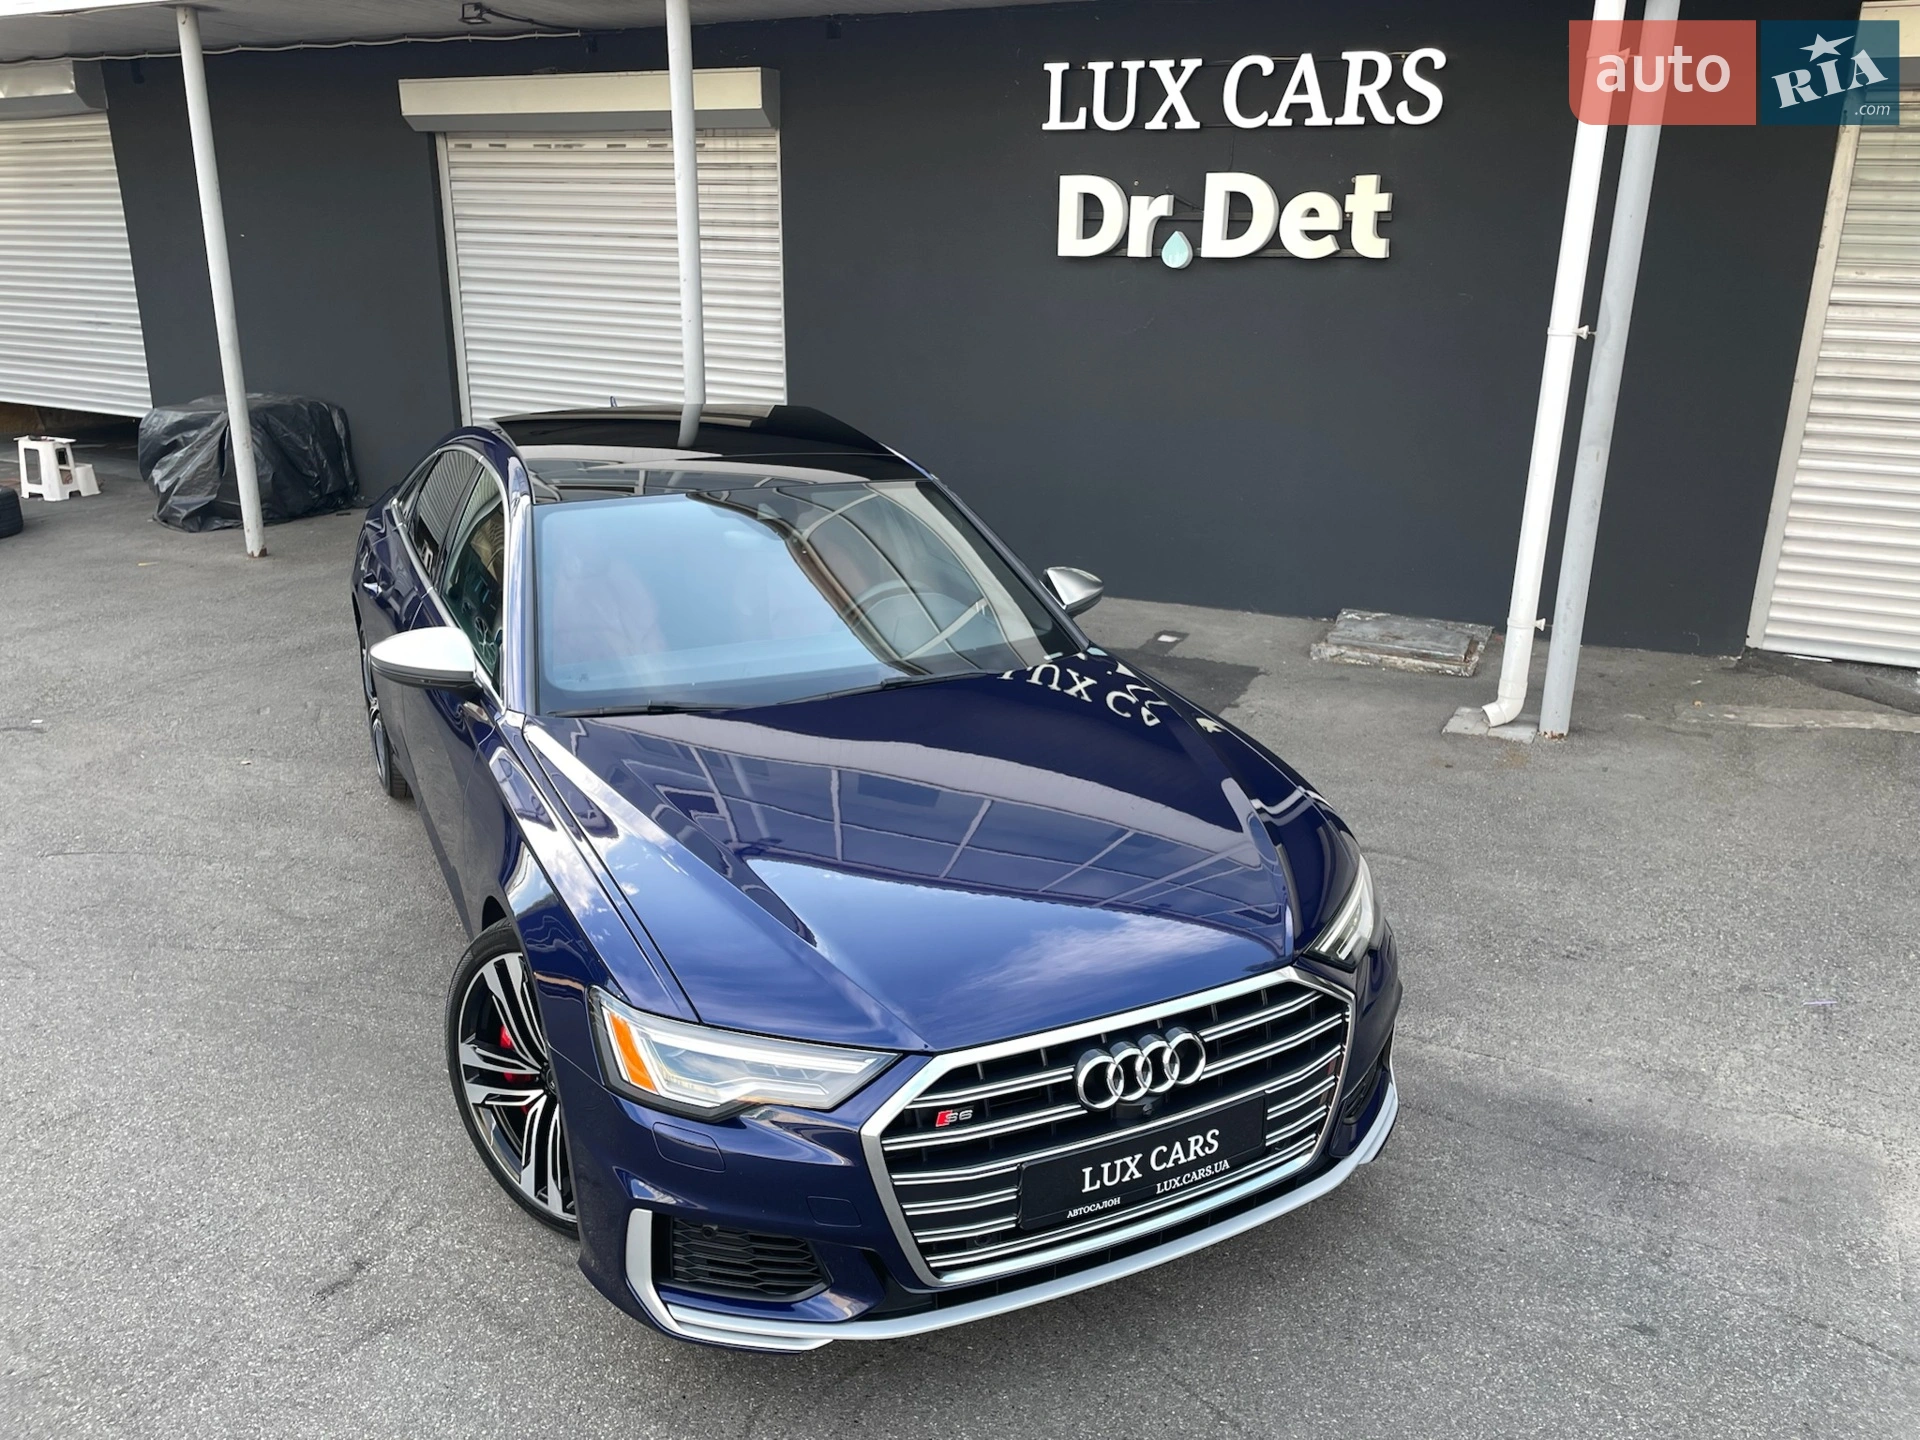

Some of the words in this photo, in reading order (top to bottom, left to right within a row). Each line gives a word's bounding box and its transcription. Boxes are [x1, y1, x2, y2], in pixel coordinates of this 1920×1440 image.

[1041, 58, 1203, 131] LUX
[1222, 47, 1447, 129] CARS
[1081, 1154, 1143, 1193] LUX
[1150, 1129, 1220, 1171] CARS
[1155, 1160, 1230, 1195] LUX.CARS.UA
[1066, 1197, 1121, 1219] АВТОСАЛОН
